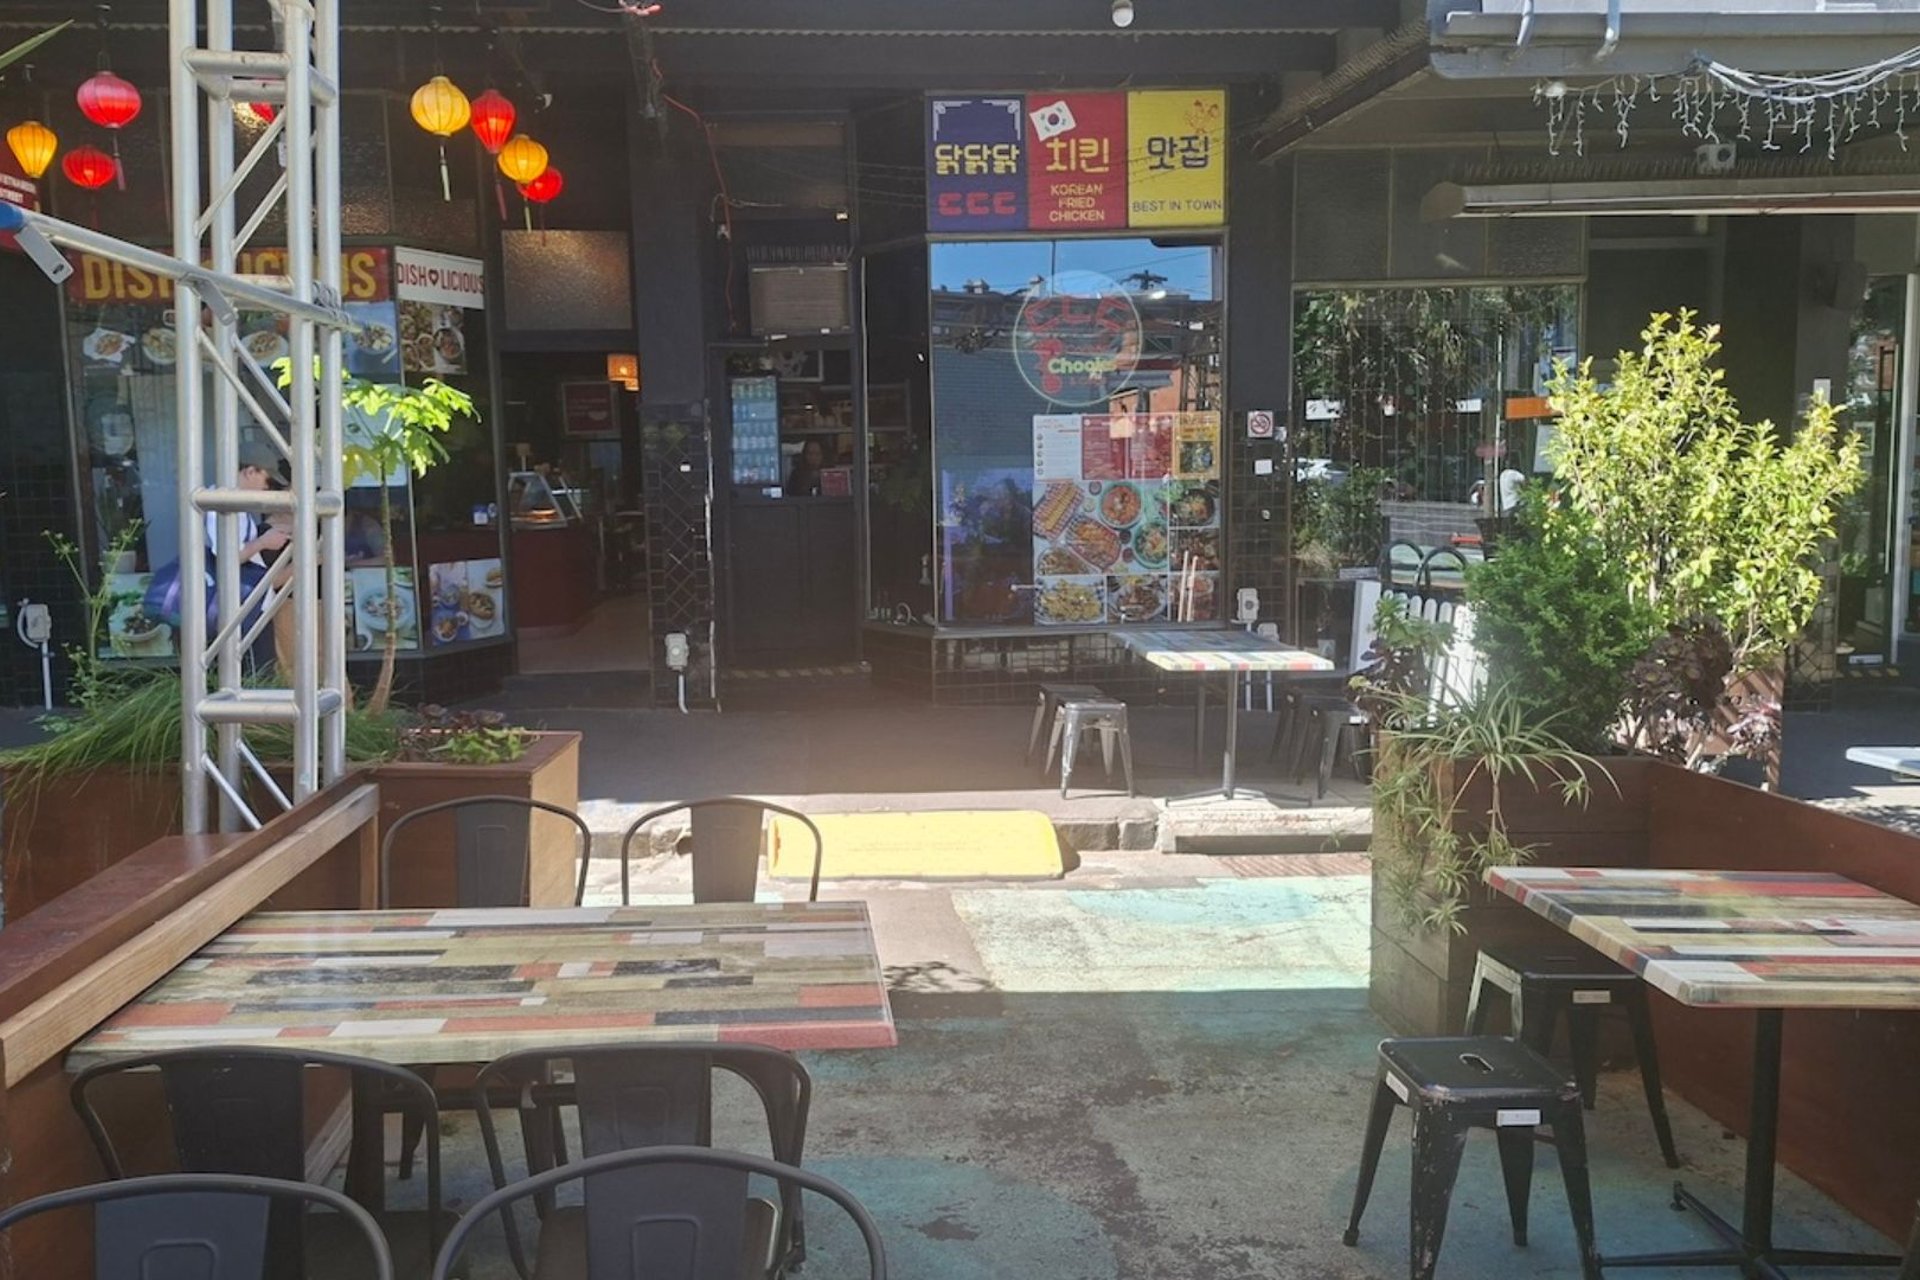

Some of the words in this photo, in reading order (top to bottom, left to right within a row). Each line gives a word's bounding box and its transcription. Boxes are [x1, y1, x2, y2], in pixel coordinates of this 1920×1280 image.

[935, 143, 1020, 175] 닭닭닭
[1046, 137, 1109, 173] 치킨
[1147, 135, 1210, 170] 맛집
[1050, 184, 1103, 196] KOREAN
[1058, 197, 1096, 208] FRIED
[1132, 201, 1166, 212] BEST
[1169, 200, 1181, 211] IN
[1185, 198, 1222, 211] TOWN
[1049, 209, 1105, 222] CHICKEN
